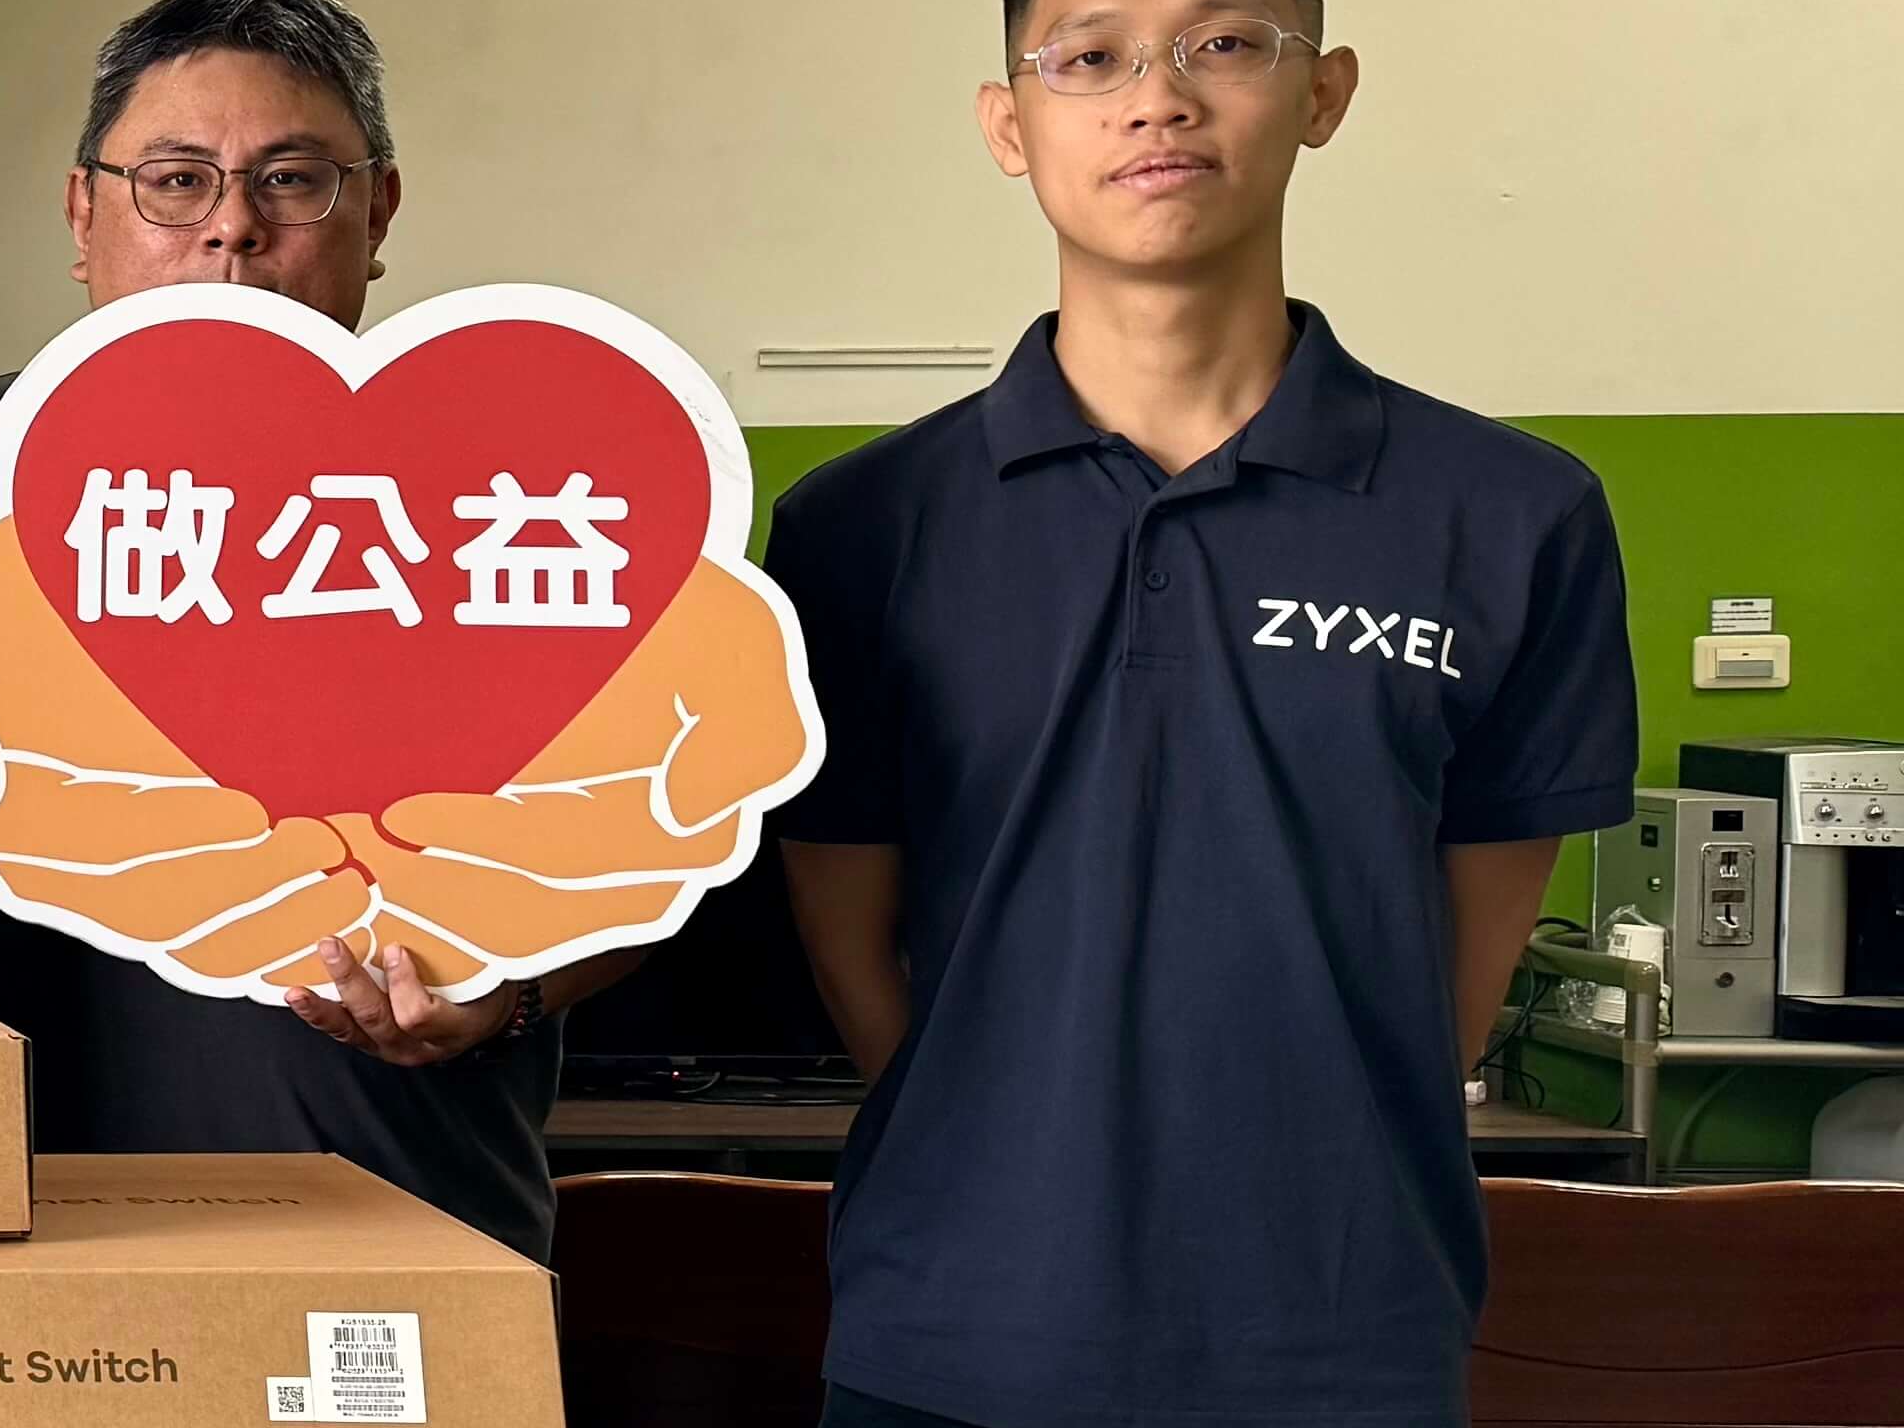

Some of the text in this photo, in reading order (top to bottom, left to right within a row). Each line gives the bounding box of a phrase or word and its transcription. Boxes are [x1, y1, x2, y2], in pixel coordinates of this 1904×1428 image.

[64, 468, 632, 629] 做公益
[1252, 597, 1462, 680] ZYXEL
[26, 1347, 179, 1383] Switch
